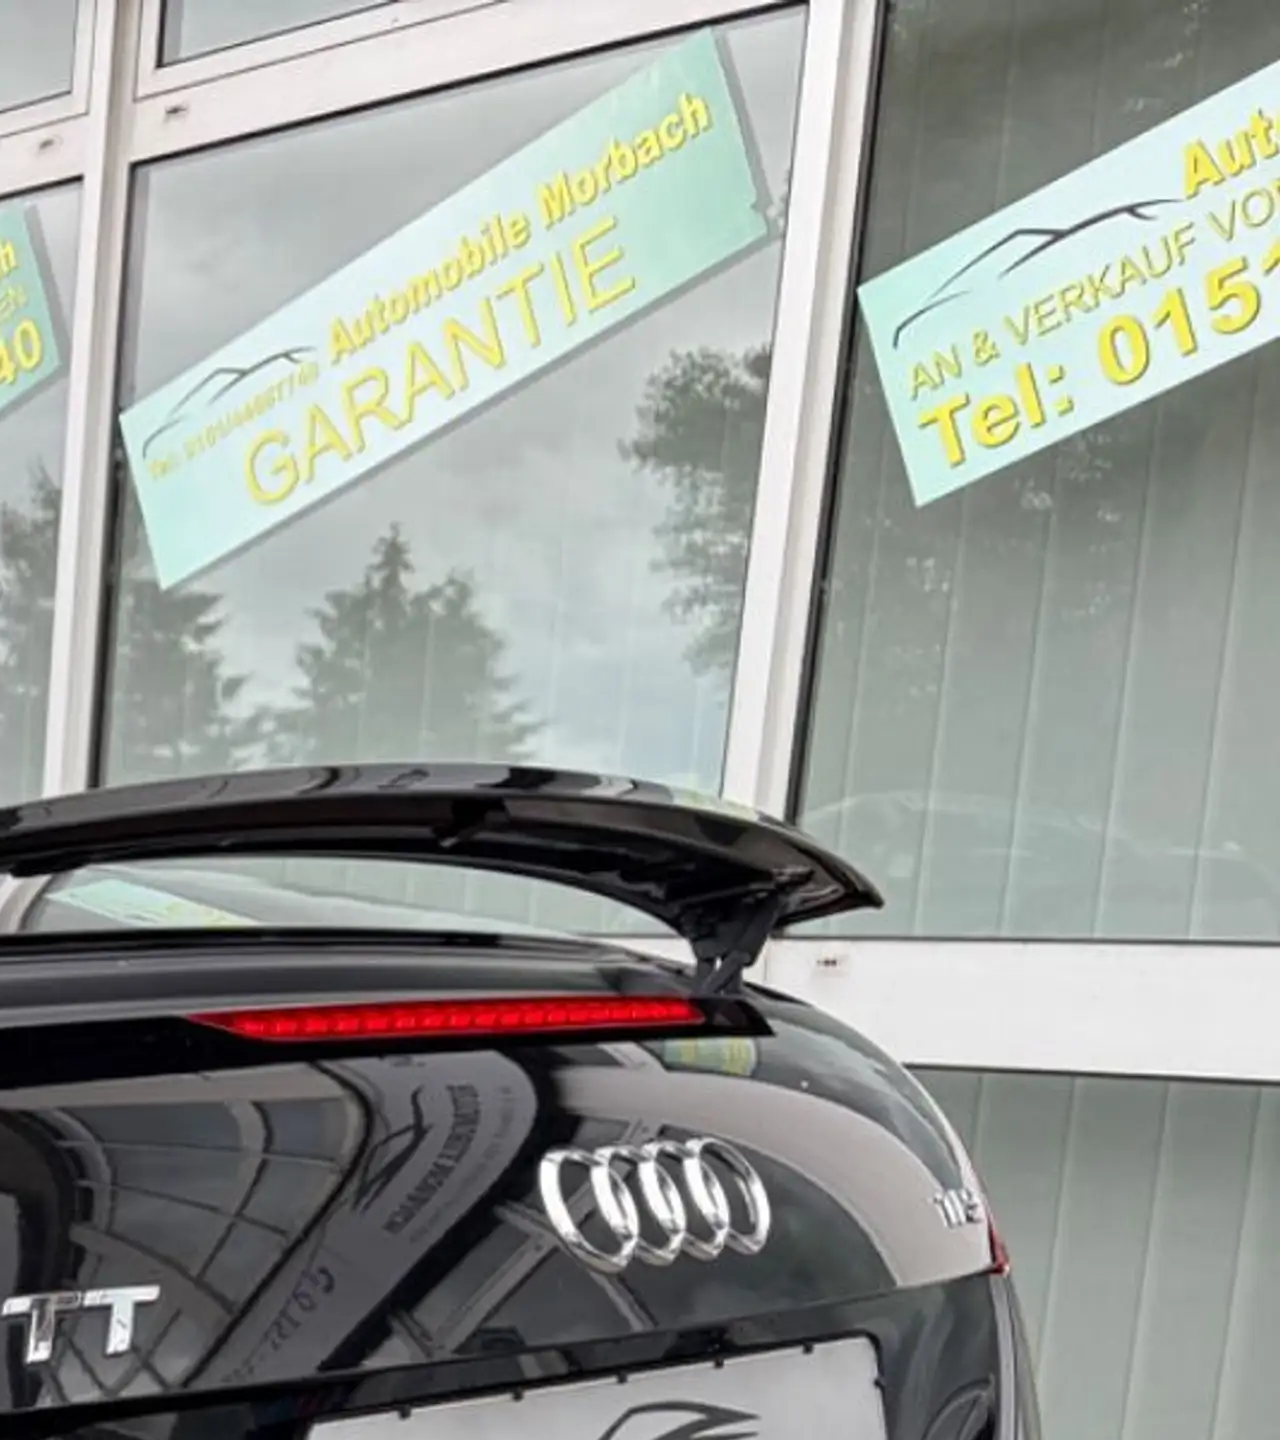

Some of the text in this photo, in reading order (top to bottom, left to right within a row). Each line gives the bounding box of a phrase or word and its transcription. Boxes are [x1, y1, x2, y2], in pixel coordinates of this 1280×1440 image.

[329, 91, 713, 363] Automobile Morbach
[1183, 107, 1280, 200] Aut
[244, 216, 637, 506] GARANTIE
[910, 186, 1280, 400] AN & VERKAUF VO
[917, 360, 1075, 469] Tel:
[0, 1284, 161, 1364] TT
